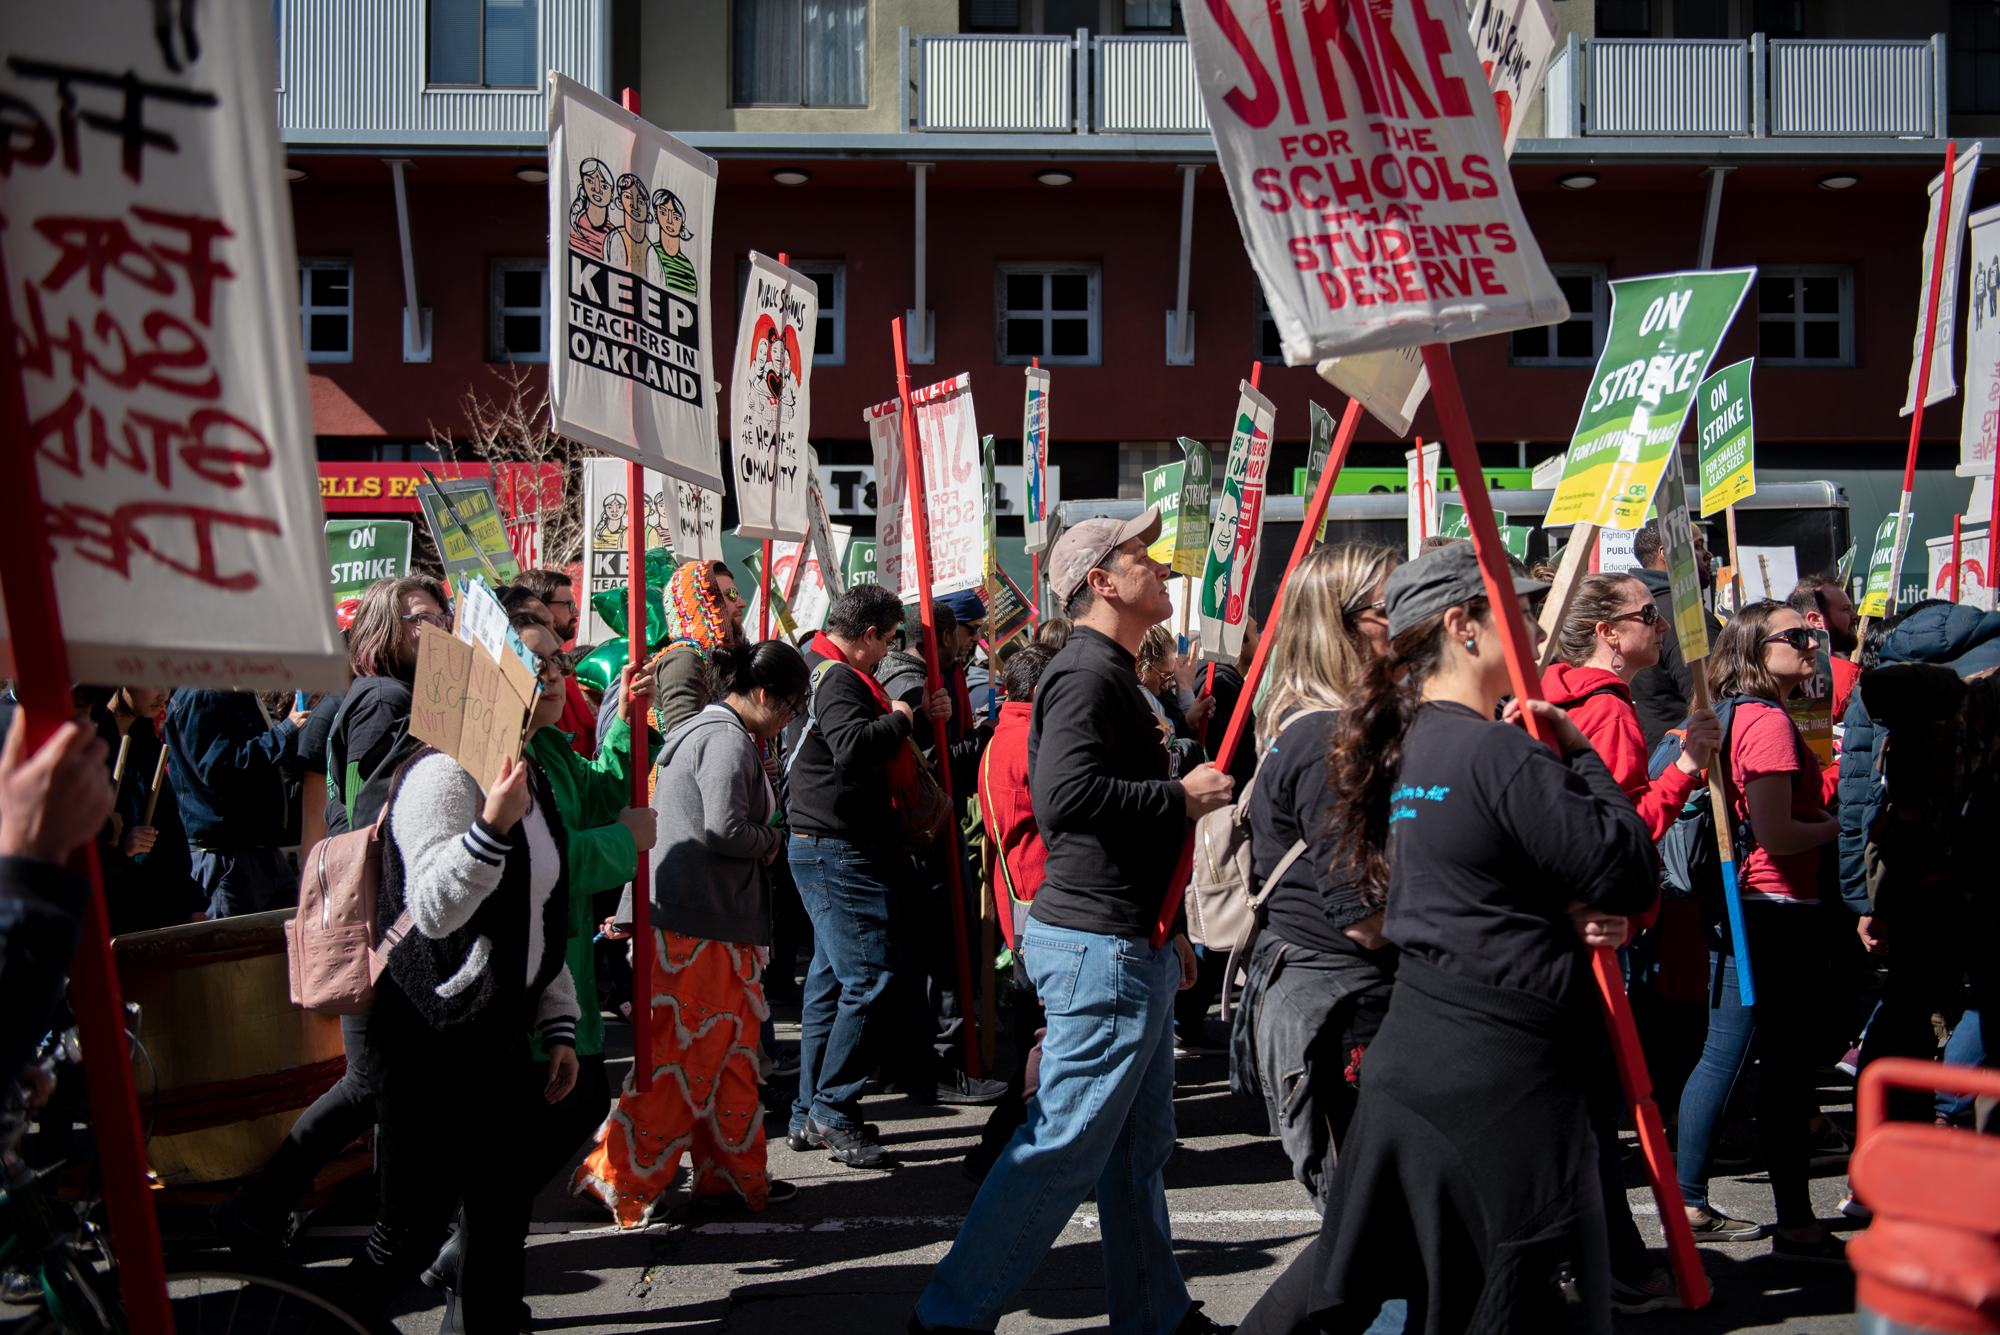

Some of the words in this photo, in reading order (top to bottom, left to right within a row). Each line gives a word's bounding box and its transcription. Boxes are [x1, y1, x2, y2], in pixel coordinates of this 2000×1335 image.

[1280, 130, 1353, 162] FOR
[1370, 122, 1438, 152] THE
[1253, 154, 1498, 213] SCHOOLS
[1322, 202, 1423, 230] THAT
[1289, 222, 1517, 271] STUDENTS
[571, 254, 694, 337] KEEP
[1317, 258, 1507, 310] DESERVE
[1638, 289, 1693, 337] ON
[570, 299, 671, 362] TEACHERS
[676, 346, 697, 370] IN
[571, 331, 698, 401] OAKLAND
[1710, 379, 1728, 412] ON
[1703, 397, 1745, 451] STRIKE
[1570, 445, 1591, 464] FOR
[1588, 442, 1598, 455] A
[1596, 430, 1642, 452] LIVIN
[1705, 456, 1718, 477] FOR
[1718, 435, 1747, 466] SMALLER
[1153, 471, 1166, 493] ON
[1192, 455, 1203, 477] ON
[1708, 465, 1727, 487] CLASS
[1727, 451, 1745, 473] SIZES
[318, 477, 381, 497] ELLS
[1185, 484, 1209, 506] STRIKE
[437, 507, 453, 529] WE
[454, 499, 474, 519] TAND
[469, 491, 490, 514] WITH
[349, 527, 377, 550] ON
[449, 533, 472, 556] OAKLA
[1601, 532, 1631, 541] Fighting
[1663, 504, 1692, 552] STR
[330, 557, 396, 585] STRIKE
[852, 570, 878, 586] STR
[428, 632, 500, 704] FUND
[417, 705, 447, 738] NOT
[1810, 717, 1829, 730] WAGE
